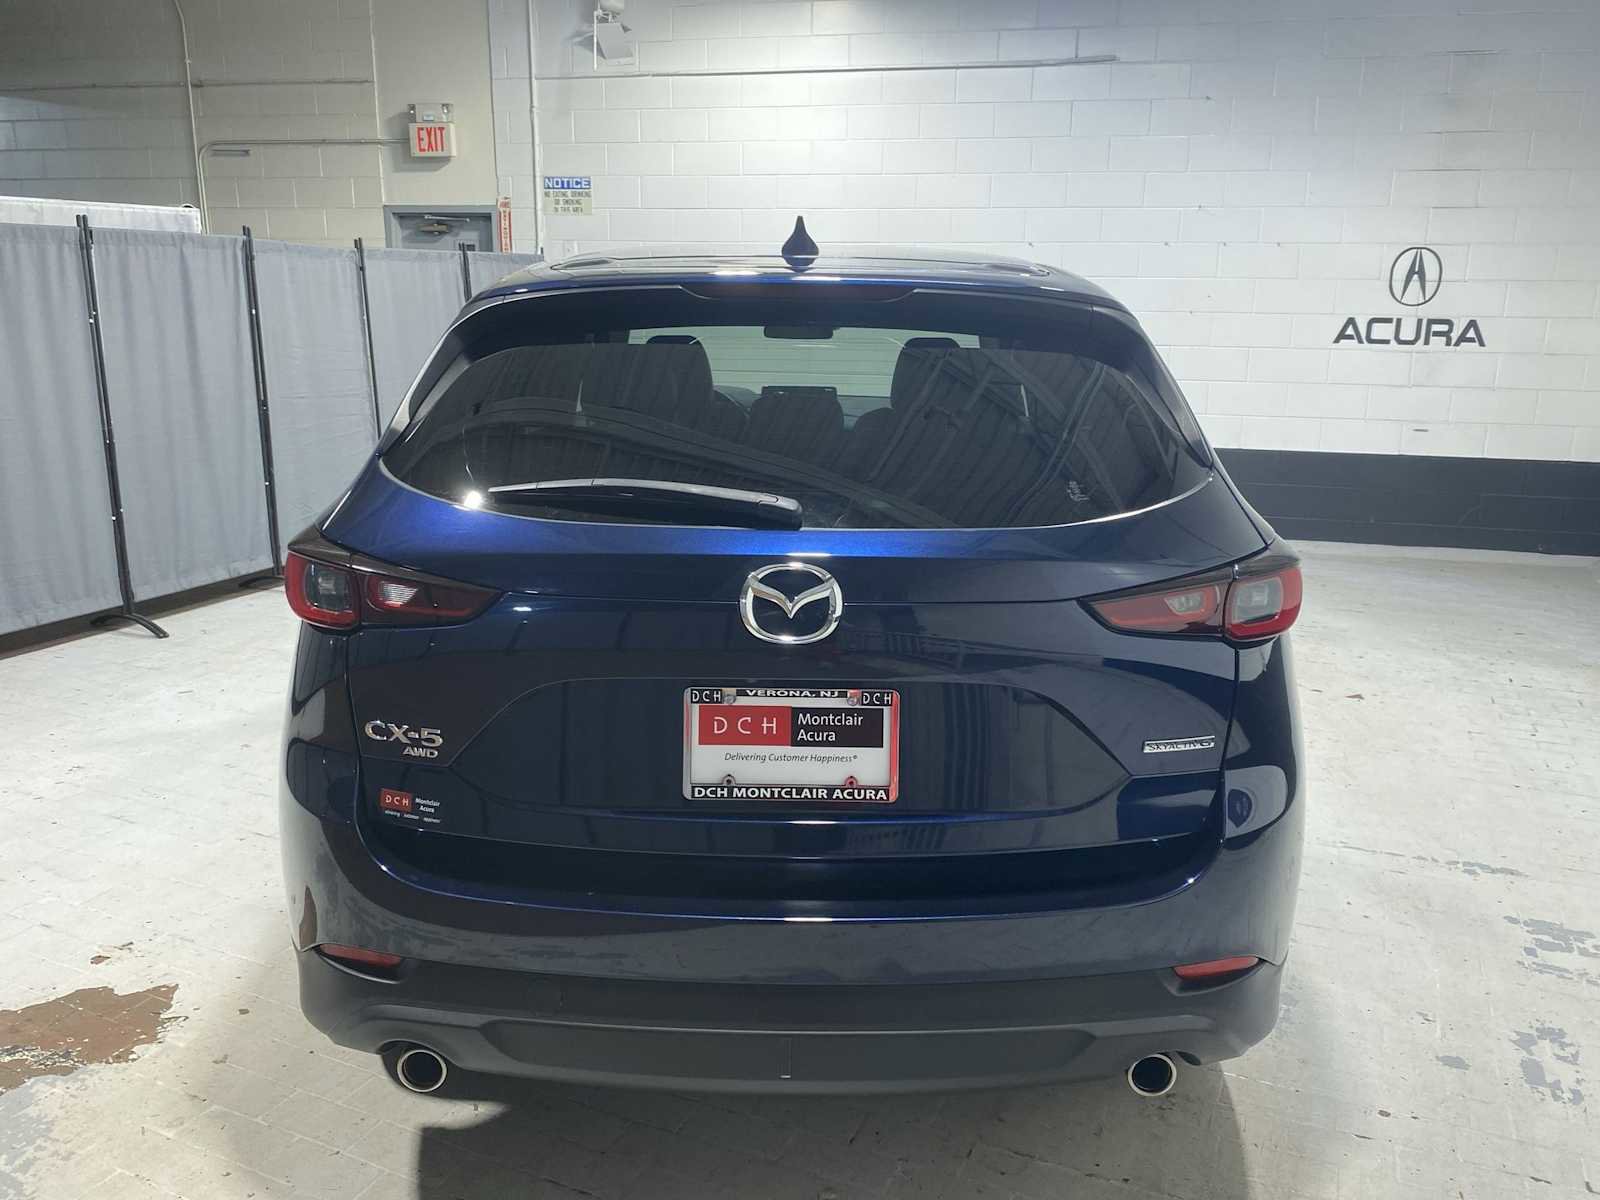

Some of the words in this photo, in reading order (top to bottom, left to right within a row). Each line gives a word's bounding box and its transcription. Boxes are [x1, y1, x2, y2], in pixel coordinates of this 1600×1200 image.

[417, 127, 445, 152] EXIT
[545, 178, 591, 188] NOTICE
[1332, 316, 1486, 348] ACURA
[692, 690, 721, 702] DCH
[863, 692, 893, 705] DCH
[713, 716, 777, 735] DCH
[798, 713, 864, 727] Montclair
[365, 720, 443, 747] CX-5
[797, 729, 836, 742] Acura
[402, 745, 439, 758] AWD
[724, 752, 767, 764] Delivering
[768, 753, 808, 762] Customer
[694, 787, 728, 798] DCH
[732, 787, 828, 799] MONTCLAIR
[832, 788, 888, 800] ACURA
[385, 794, 409, 807] DCH
